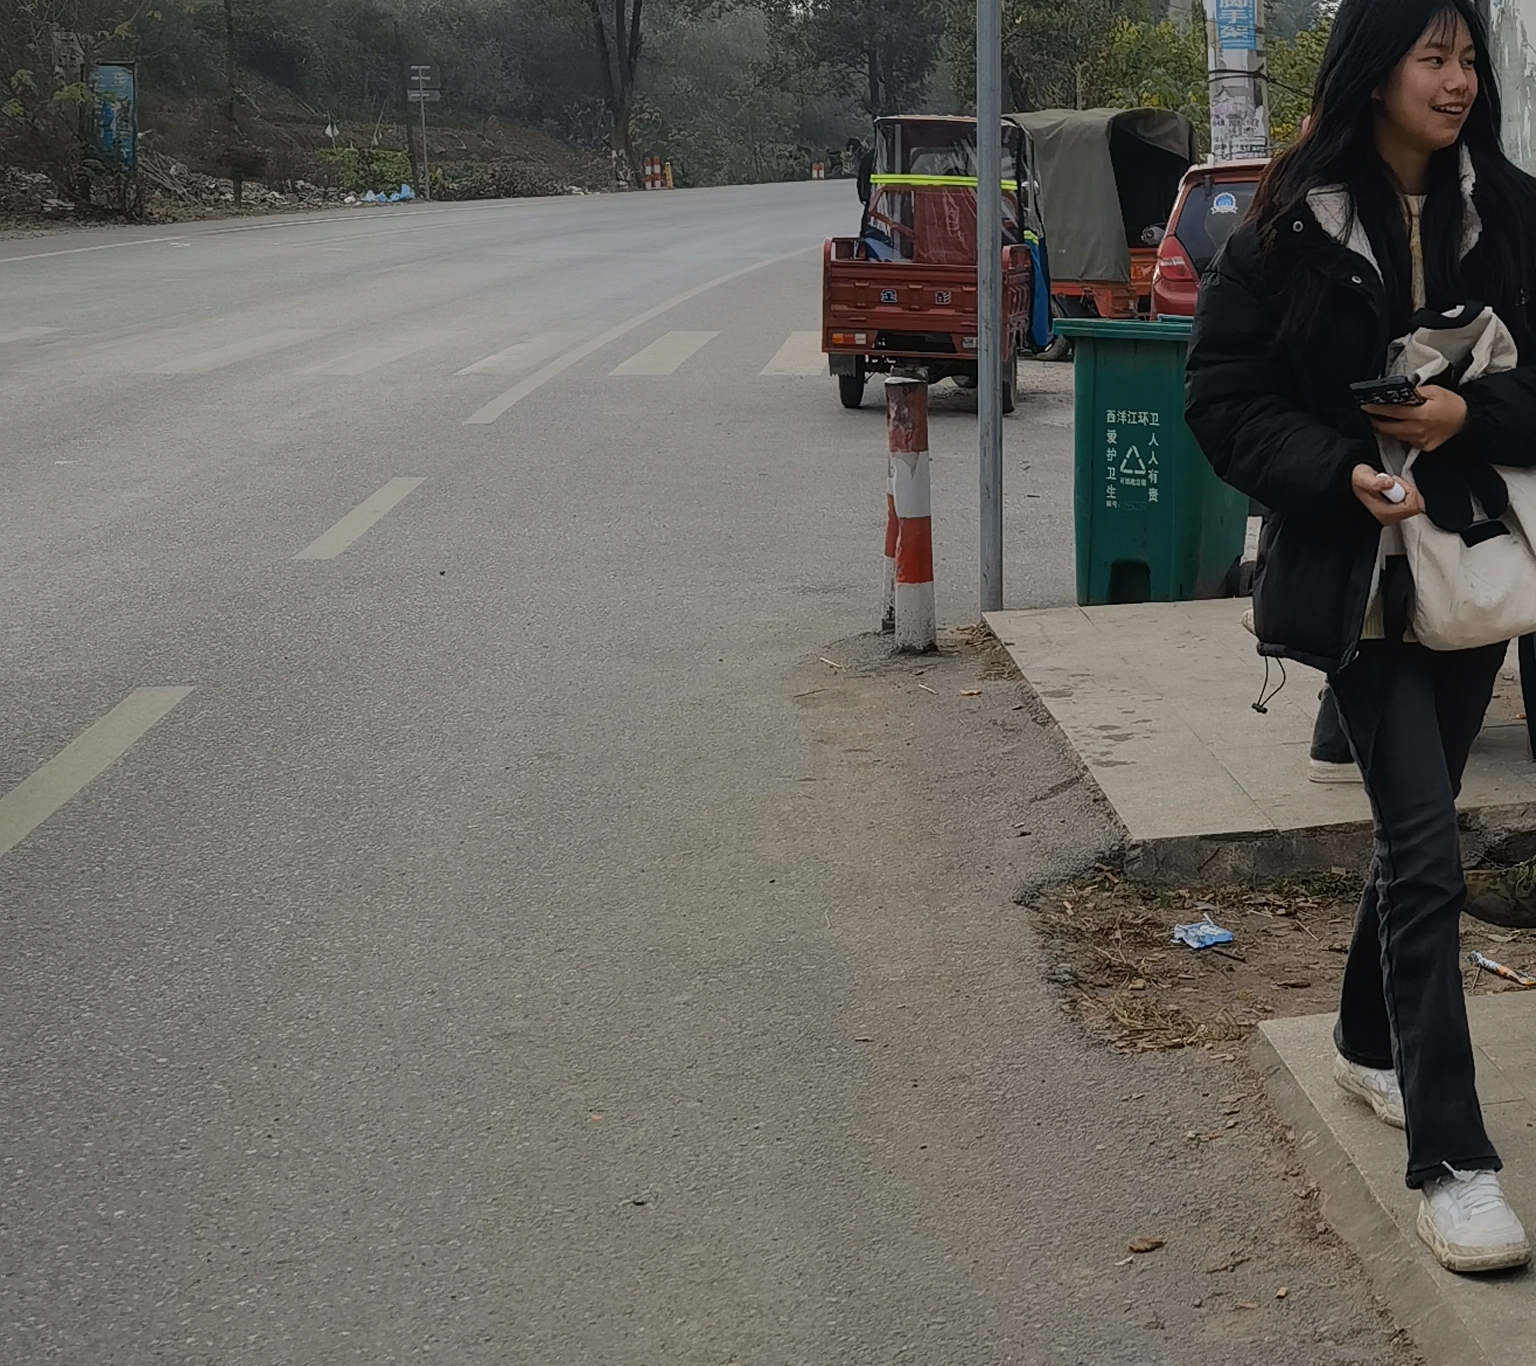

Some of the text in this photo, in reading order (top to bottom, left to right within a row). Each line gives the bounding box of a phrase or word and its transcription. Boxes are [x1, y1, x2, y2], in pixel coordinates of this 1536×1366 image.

[1106, 409, 1160, 427] 西洋江环卫
[1106, 429, 1117, 499] 爱护卫生
[1148, 432, 1159, 502] 人人有责
